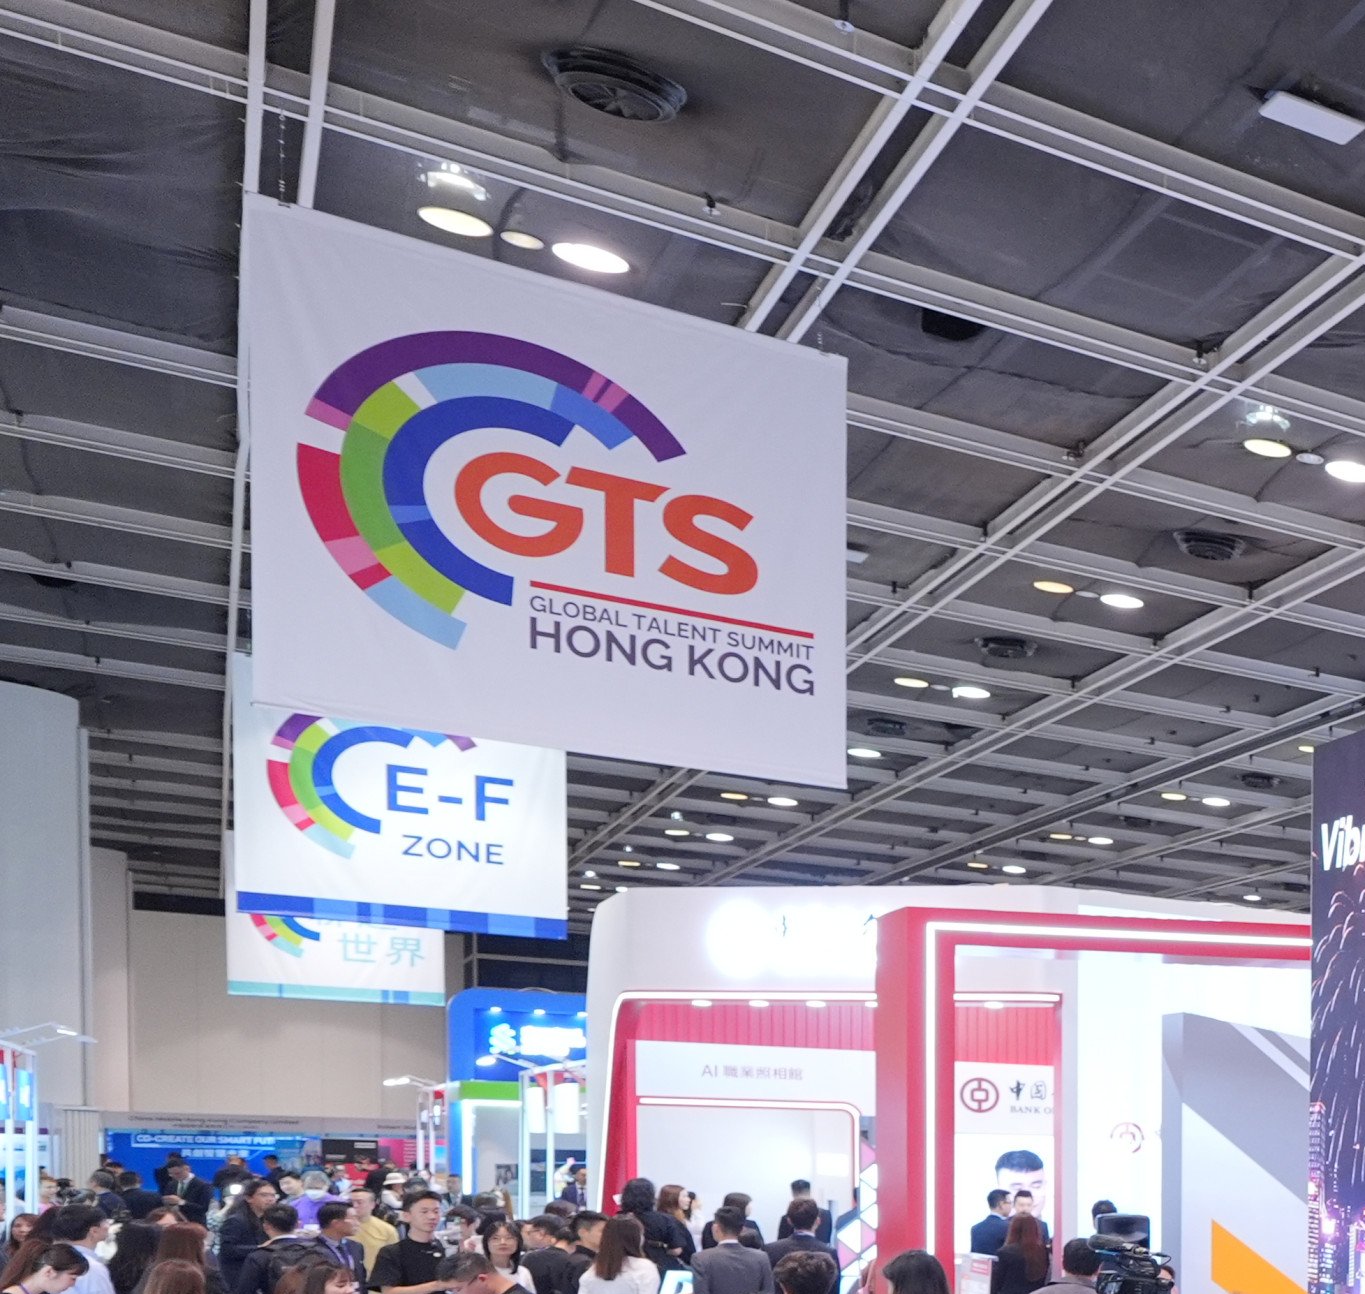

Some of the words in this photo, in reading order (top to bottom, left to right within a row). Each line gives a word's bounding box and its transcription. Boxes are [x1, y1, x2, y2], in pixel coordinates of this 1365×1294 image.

[454, 451, 758, 596] GTS
[529, 595, 628, 629] GLOBAL
[631, 613, 722, 645] TALENT
[727, 632, 815, 661] SUMMIT
[529, 616, 673, 673] HONG
[688, 647, 815, 697] KONG
[386, 763, 514, 821] E-F
[401, 834, 505, 865] ZONE
[337, 932, 425, 968] 世界
[701, 1064, 717, 1078] AI
[1010, 1105, 1041, 1114] BANK
[136, 1134, 194, 1144] CO-CREATE
[195, 1135, 217, 1144] OUR
[217, 1135, 252, 1145] SMART
